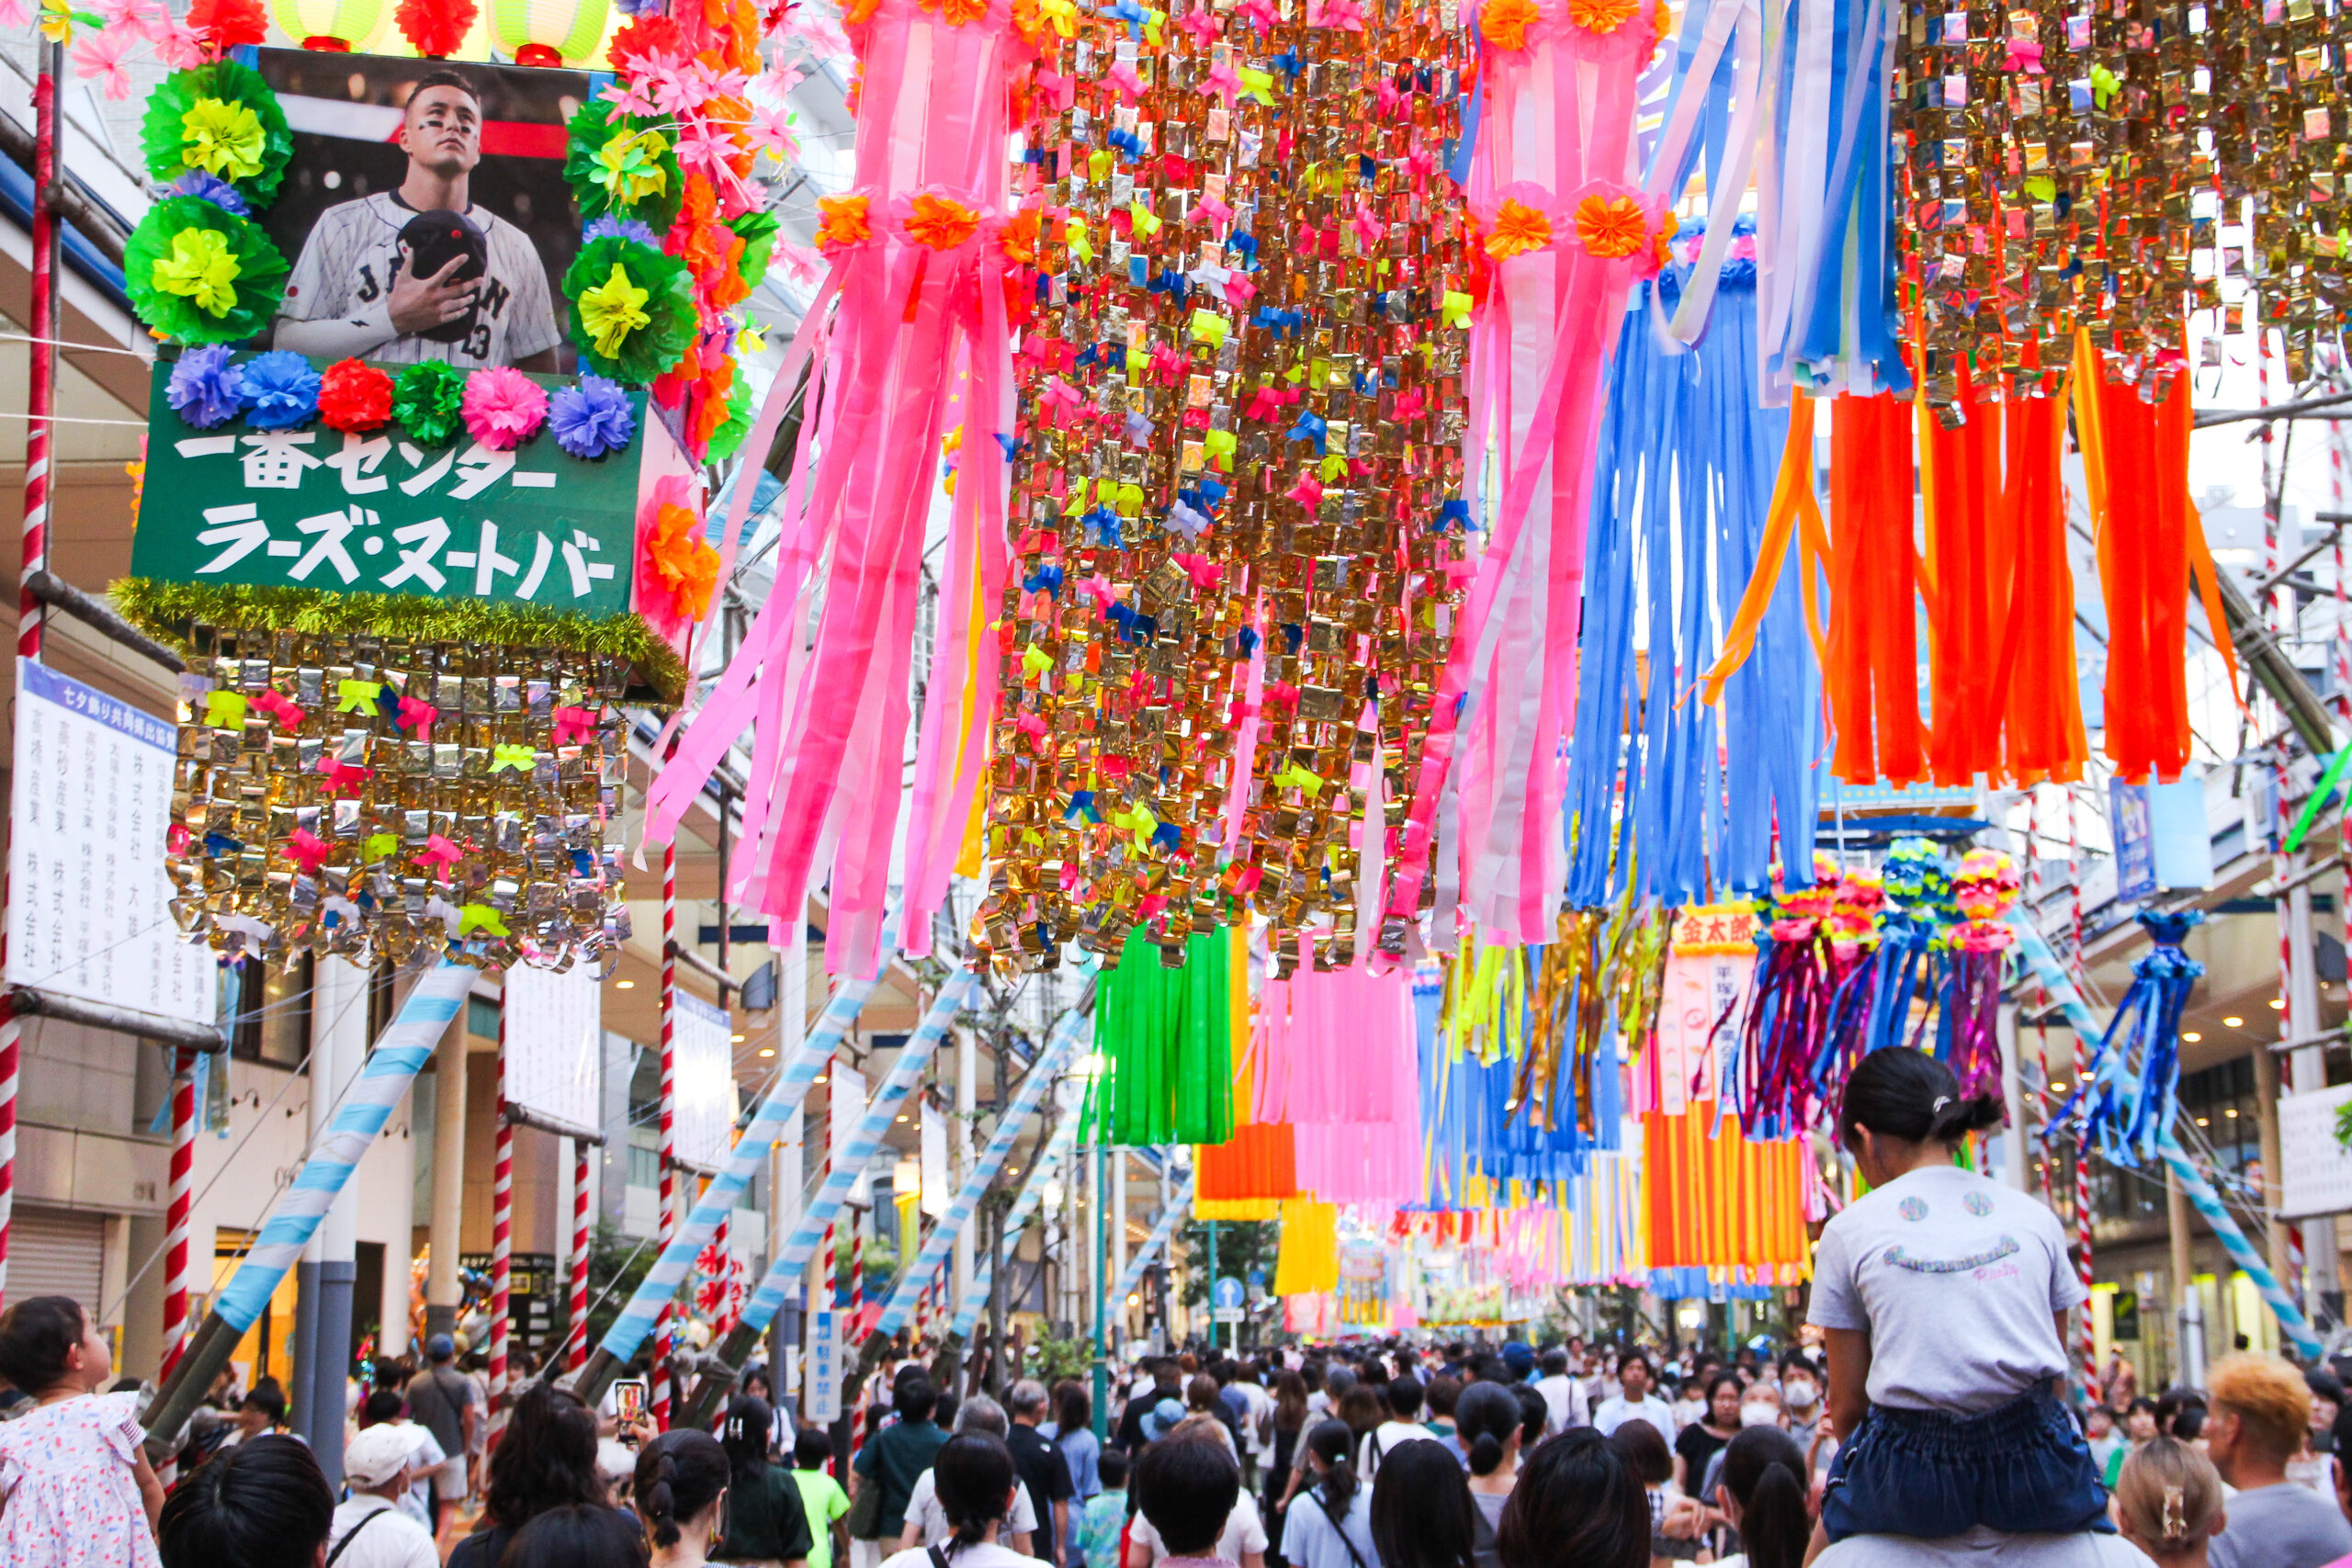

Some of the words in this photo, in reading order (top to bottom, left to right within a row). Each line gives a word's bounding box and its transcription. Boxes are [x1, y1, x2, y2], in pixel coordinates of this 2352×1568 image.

[174, 429, 557, 501] 一番センター
[194, 502, 616, 601] ラーズ・ヌートバー
[1681, 915, 1754, 944] 金太郎
